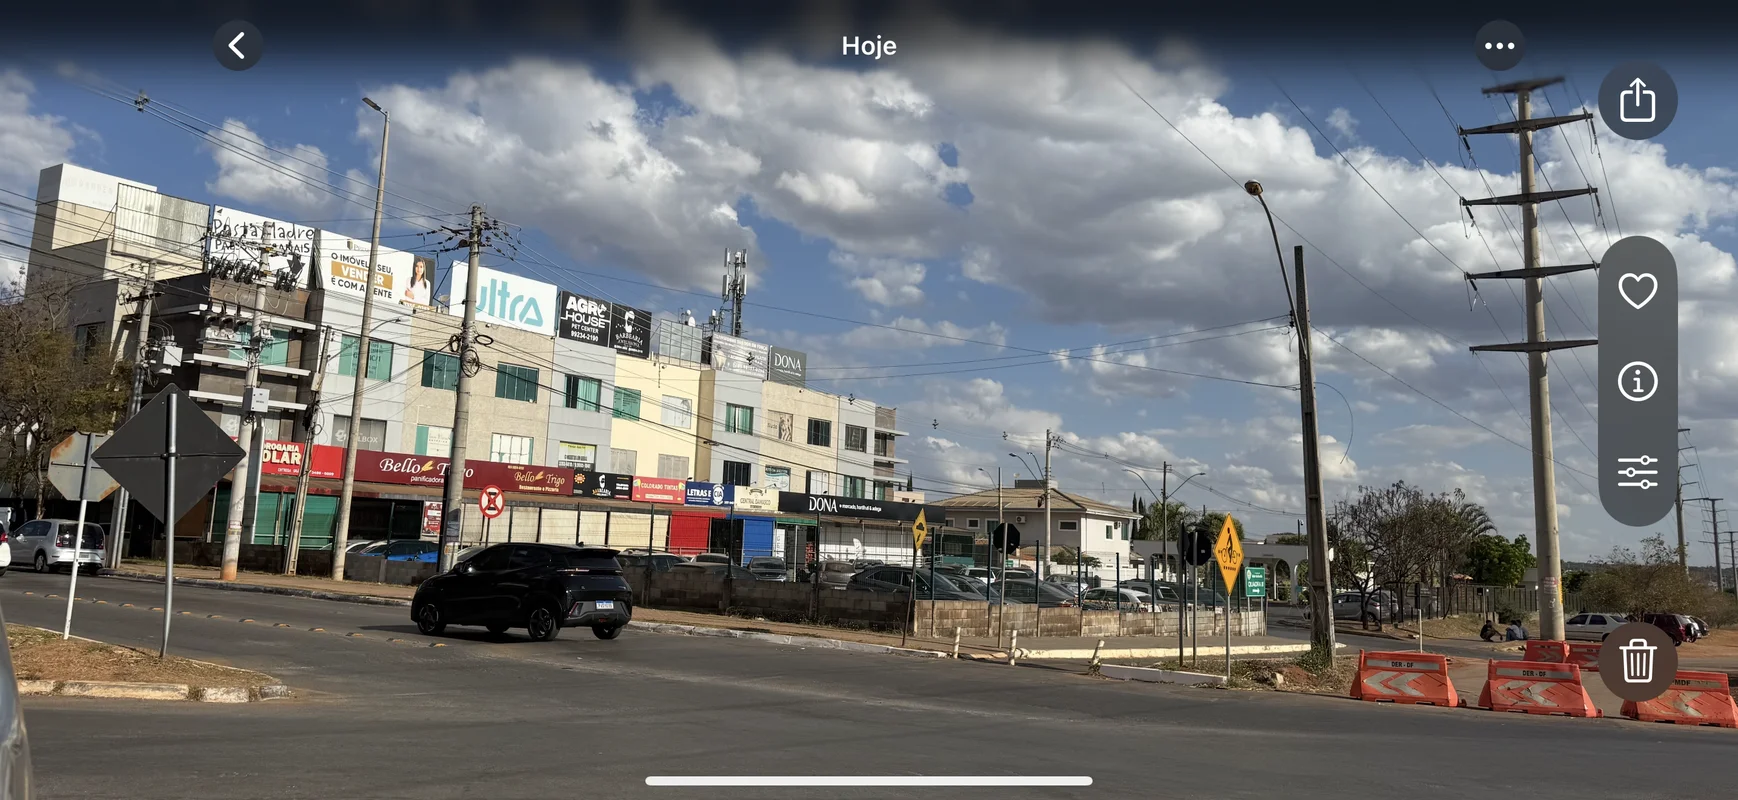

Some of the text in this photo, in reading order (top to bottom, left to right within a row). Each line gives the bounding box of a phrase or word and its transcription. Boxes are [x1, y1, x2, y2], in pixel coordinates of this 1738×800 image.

[331, 252, 338, 260] O
[340, 254, 370, 269] IMÓVEL
[341, 265, 385, 285] VENER
[331, 276, 393, 299] É COM A ENTE
[563, 311, 609, 329] HOUSE
[571, 323, 599, 334] PET CENTER
[775, 353, 802, 372] DONA
[265, 443, 300, 453] ROGARIA
[380, 458, 421, 474] Bello
[411, 475, 445, 484] panificadora
[514, 471, 566, 487] Bello Trigo
[641, 482, 664, 490] COLORADO
[687, 488, 708, 497] LETRAS
[708, 490, 712, 498] E
[809, 496, 838, 513] DONA
